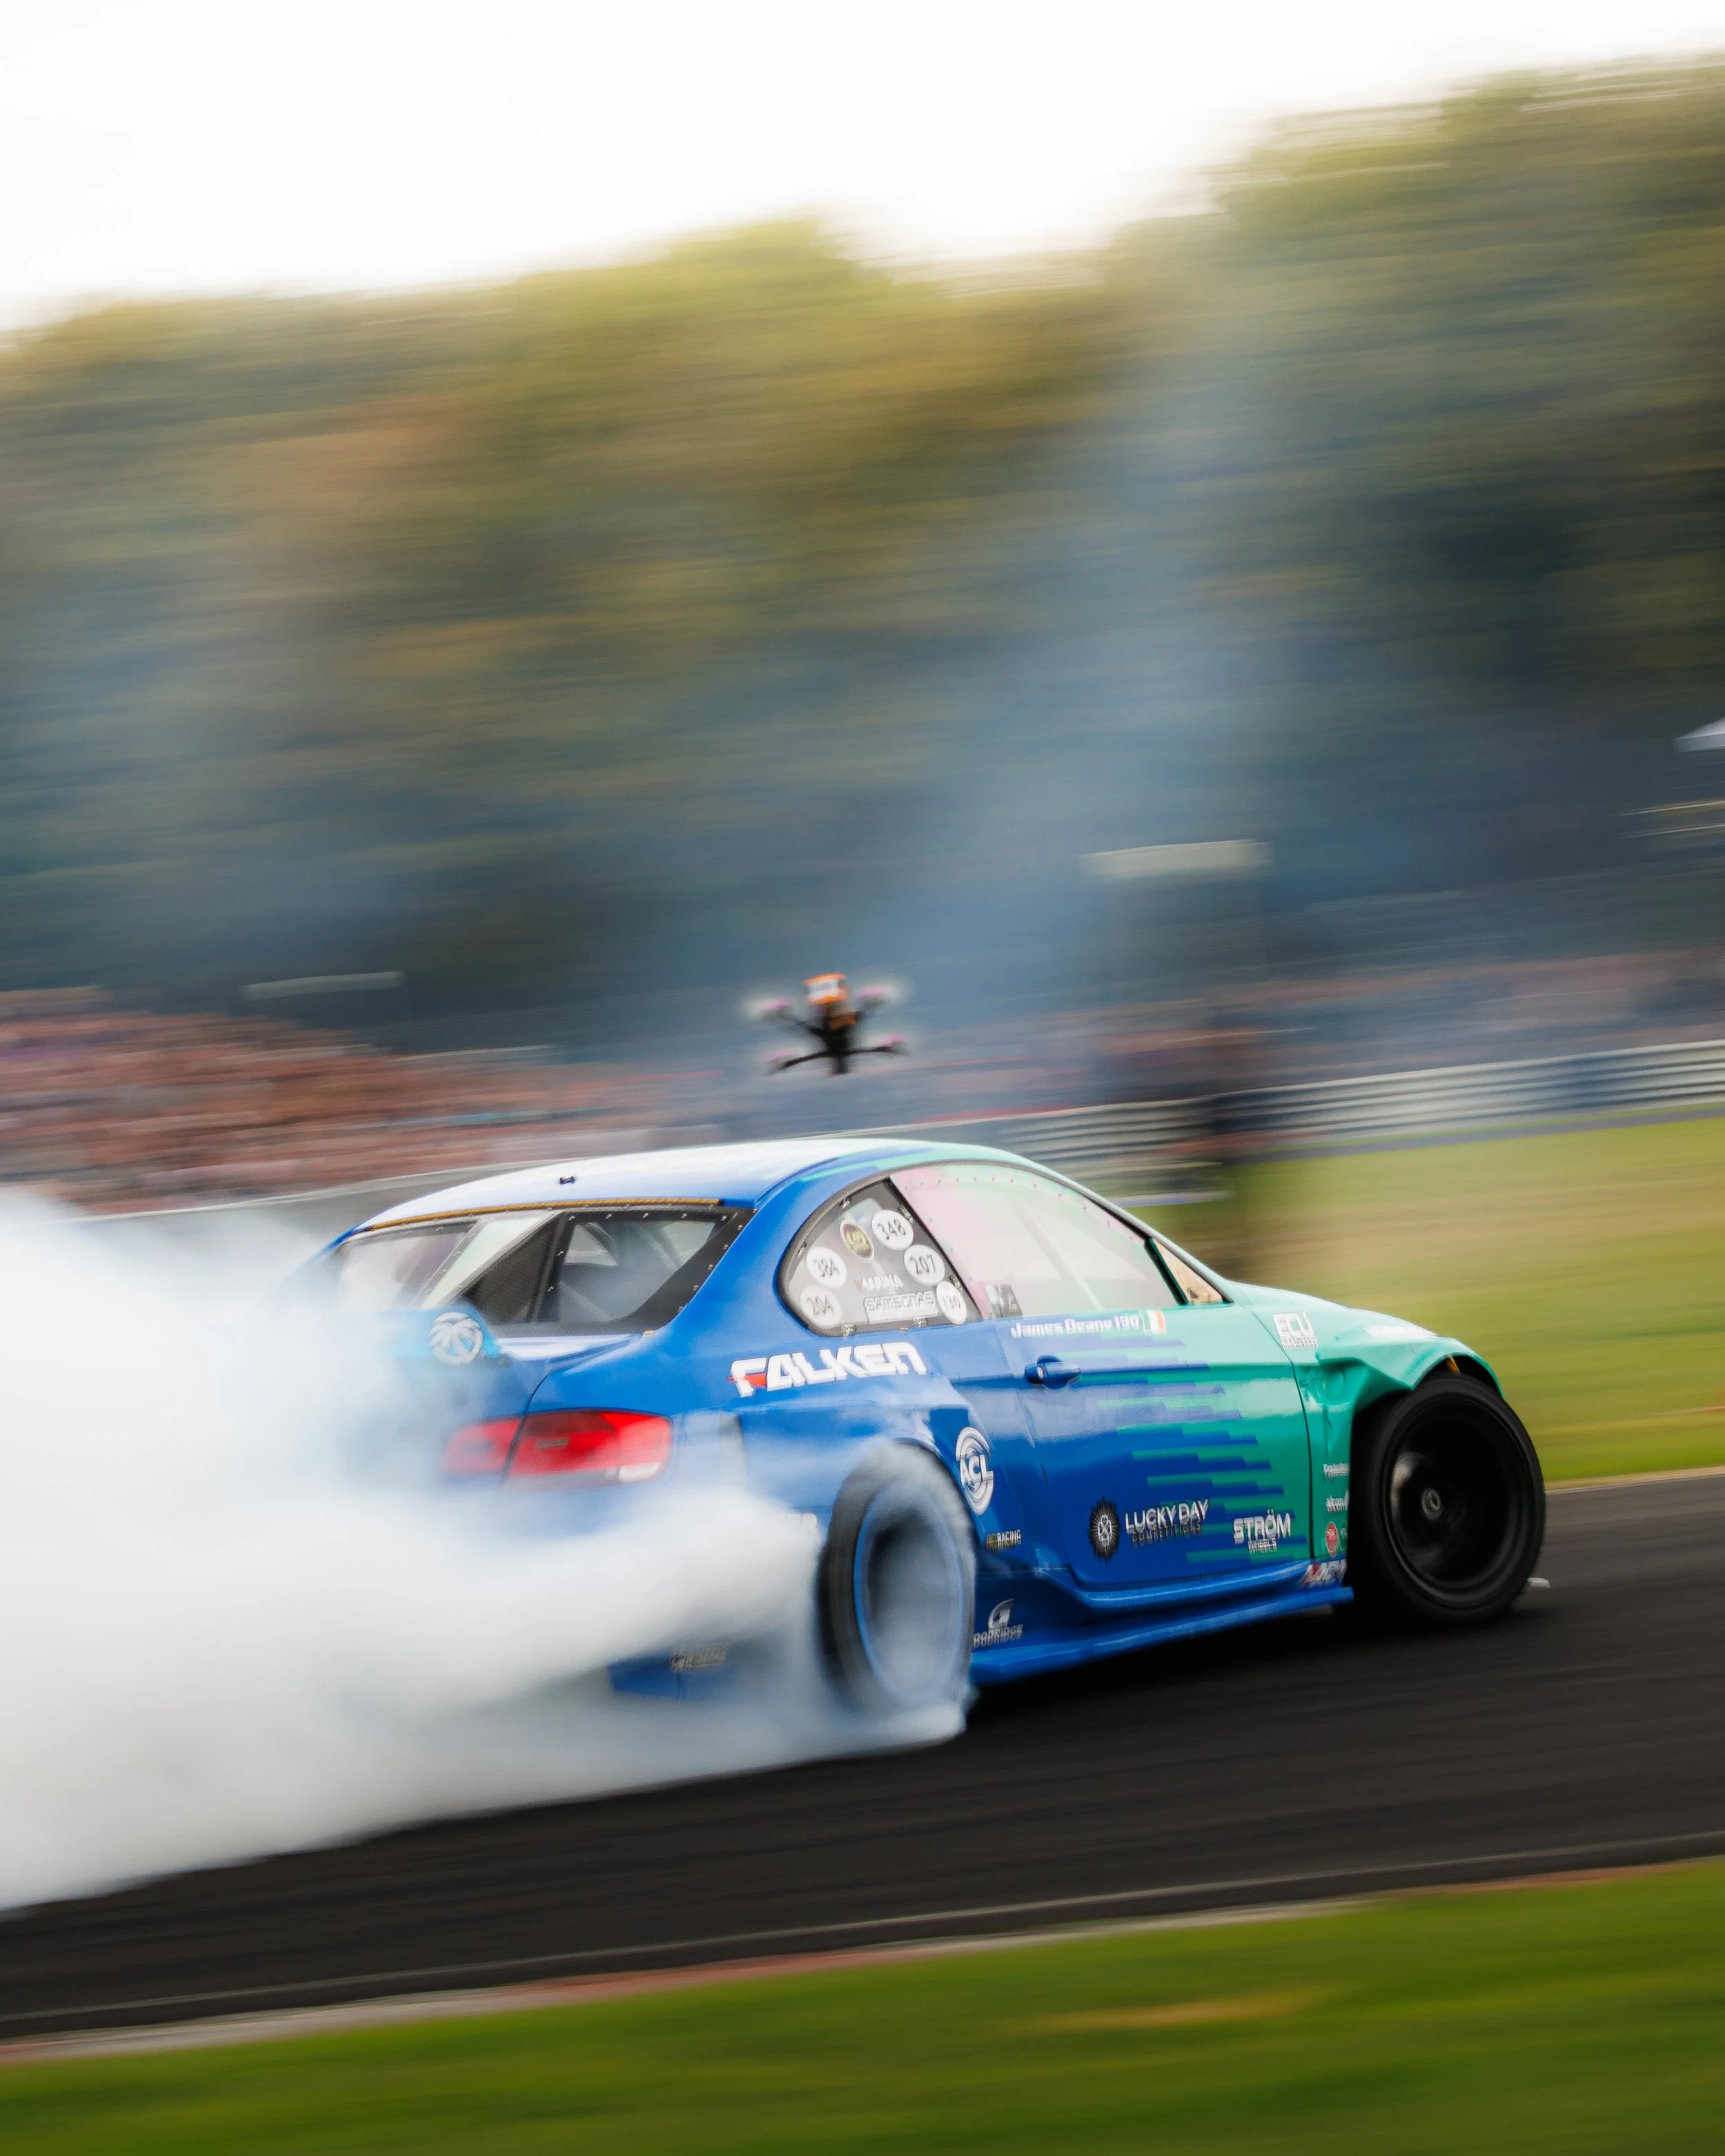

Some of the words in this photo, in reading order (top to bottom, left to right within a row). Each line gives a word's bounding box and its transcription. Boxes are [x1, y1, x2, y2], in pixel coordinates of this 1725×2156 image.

[876, 1218, 907, 1240] 348
[813, 1256, 840, 1278] 384
[909, 1254, 936, 1275] 207
[1011, 1321, 1064, 1338] James
[1065, 1318, 1113, 1335] Deane
[1272, 1311, 1314, 1337] ECU
[1281, 1334, 1319, 1351] MASTER
[729, 1341, 928, 1398] FALKEN
[960, 1454, 994, 1485] ACL
[1125, 1504, 1177, 1535] LUCKY
[1179, 1499, 1209, 1525] DAY
[1233, 1508, 1292, 1544] STRÖM
[997, 1529, 1022, 1550] RACING
[1132, 1519, 1203, 1548] COMPETITIONS
[1248, 1537, 1278, 1555] WHEELS
